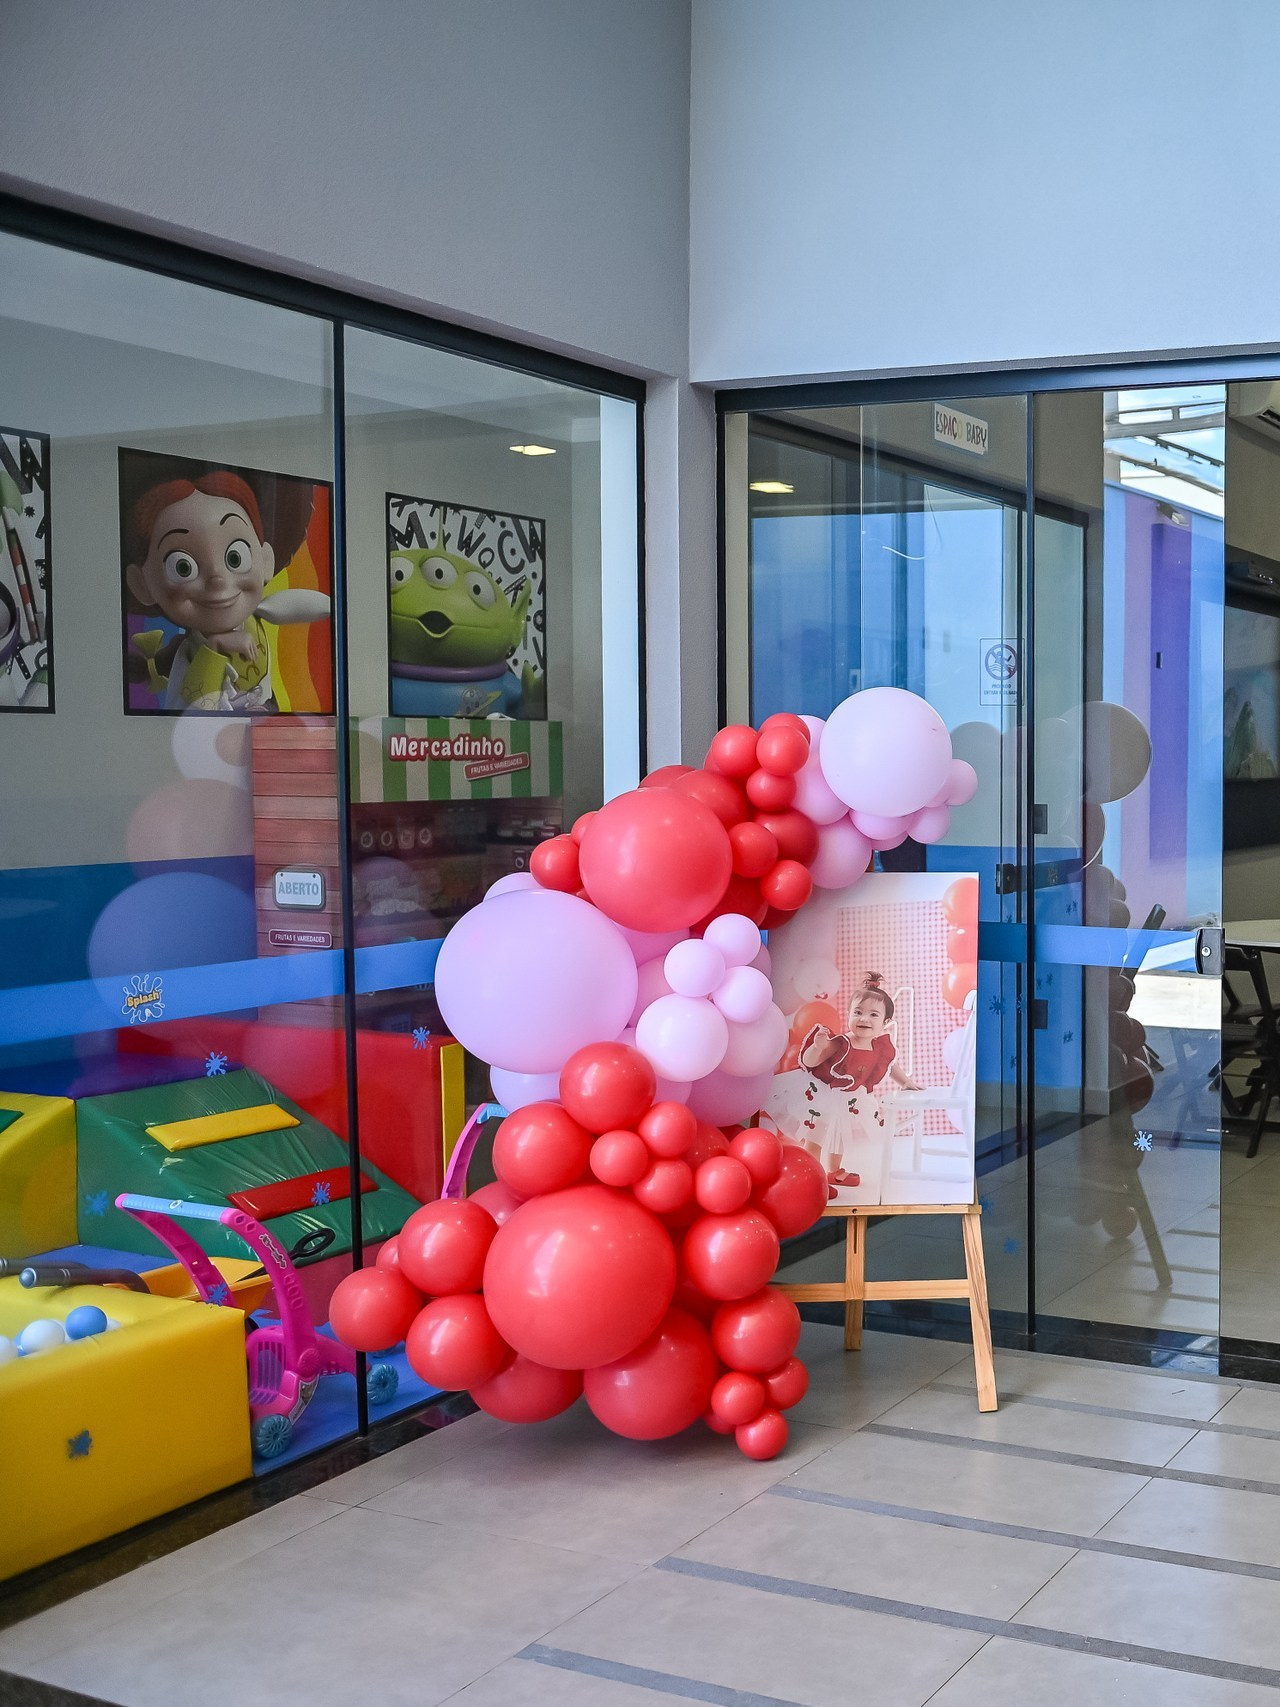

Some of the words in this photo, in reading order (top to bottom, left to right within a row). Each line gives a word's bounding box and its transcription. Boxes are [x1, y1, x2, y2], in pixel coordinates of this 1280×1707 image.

[936, 411, 964, 440] ESPAÇO
[966, 422, 987, 448] BABY
[390, 736, 504, 756] Mercadinho
[470, 764, 490, 774] FRUTAS
[494, 757, 523, 769] VARIEDADES
[278, 881, 319, 896] ABERTO
[275, 933, 293, 942] FRUTAS
[297, 935, 326, 943] VARIEDADES
[127, 990, 160, 1008] Splash
